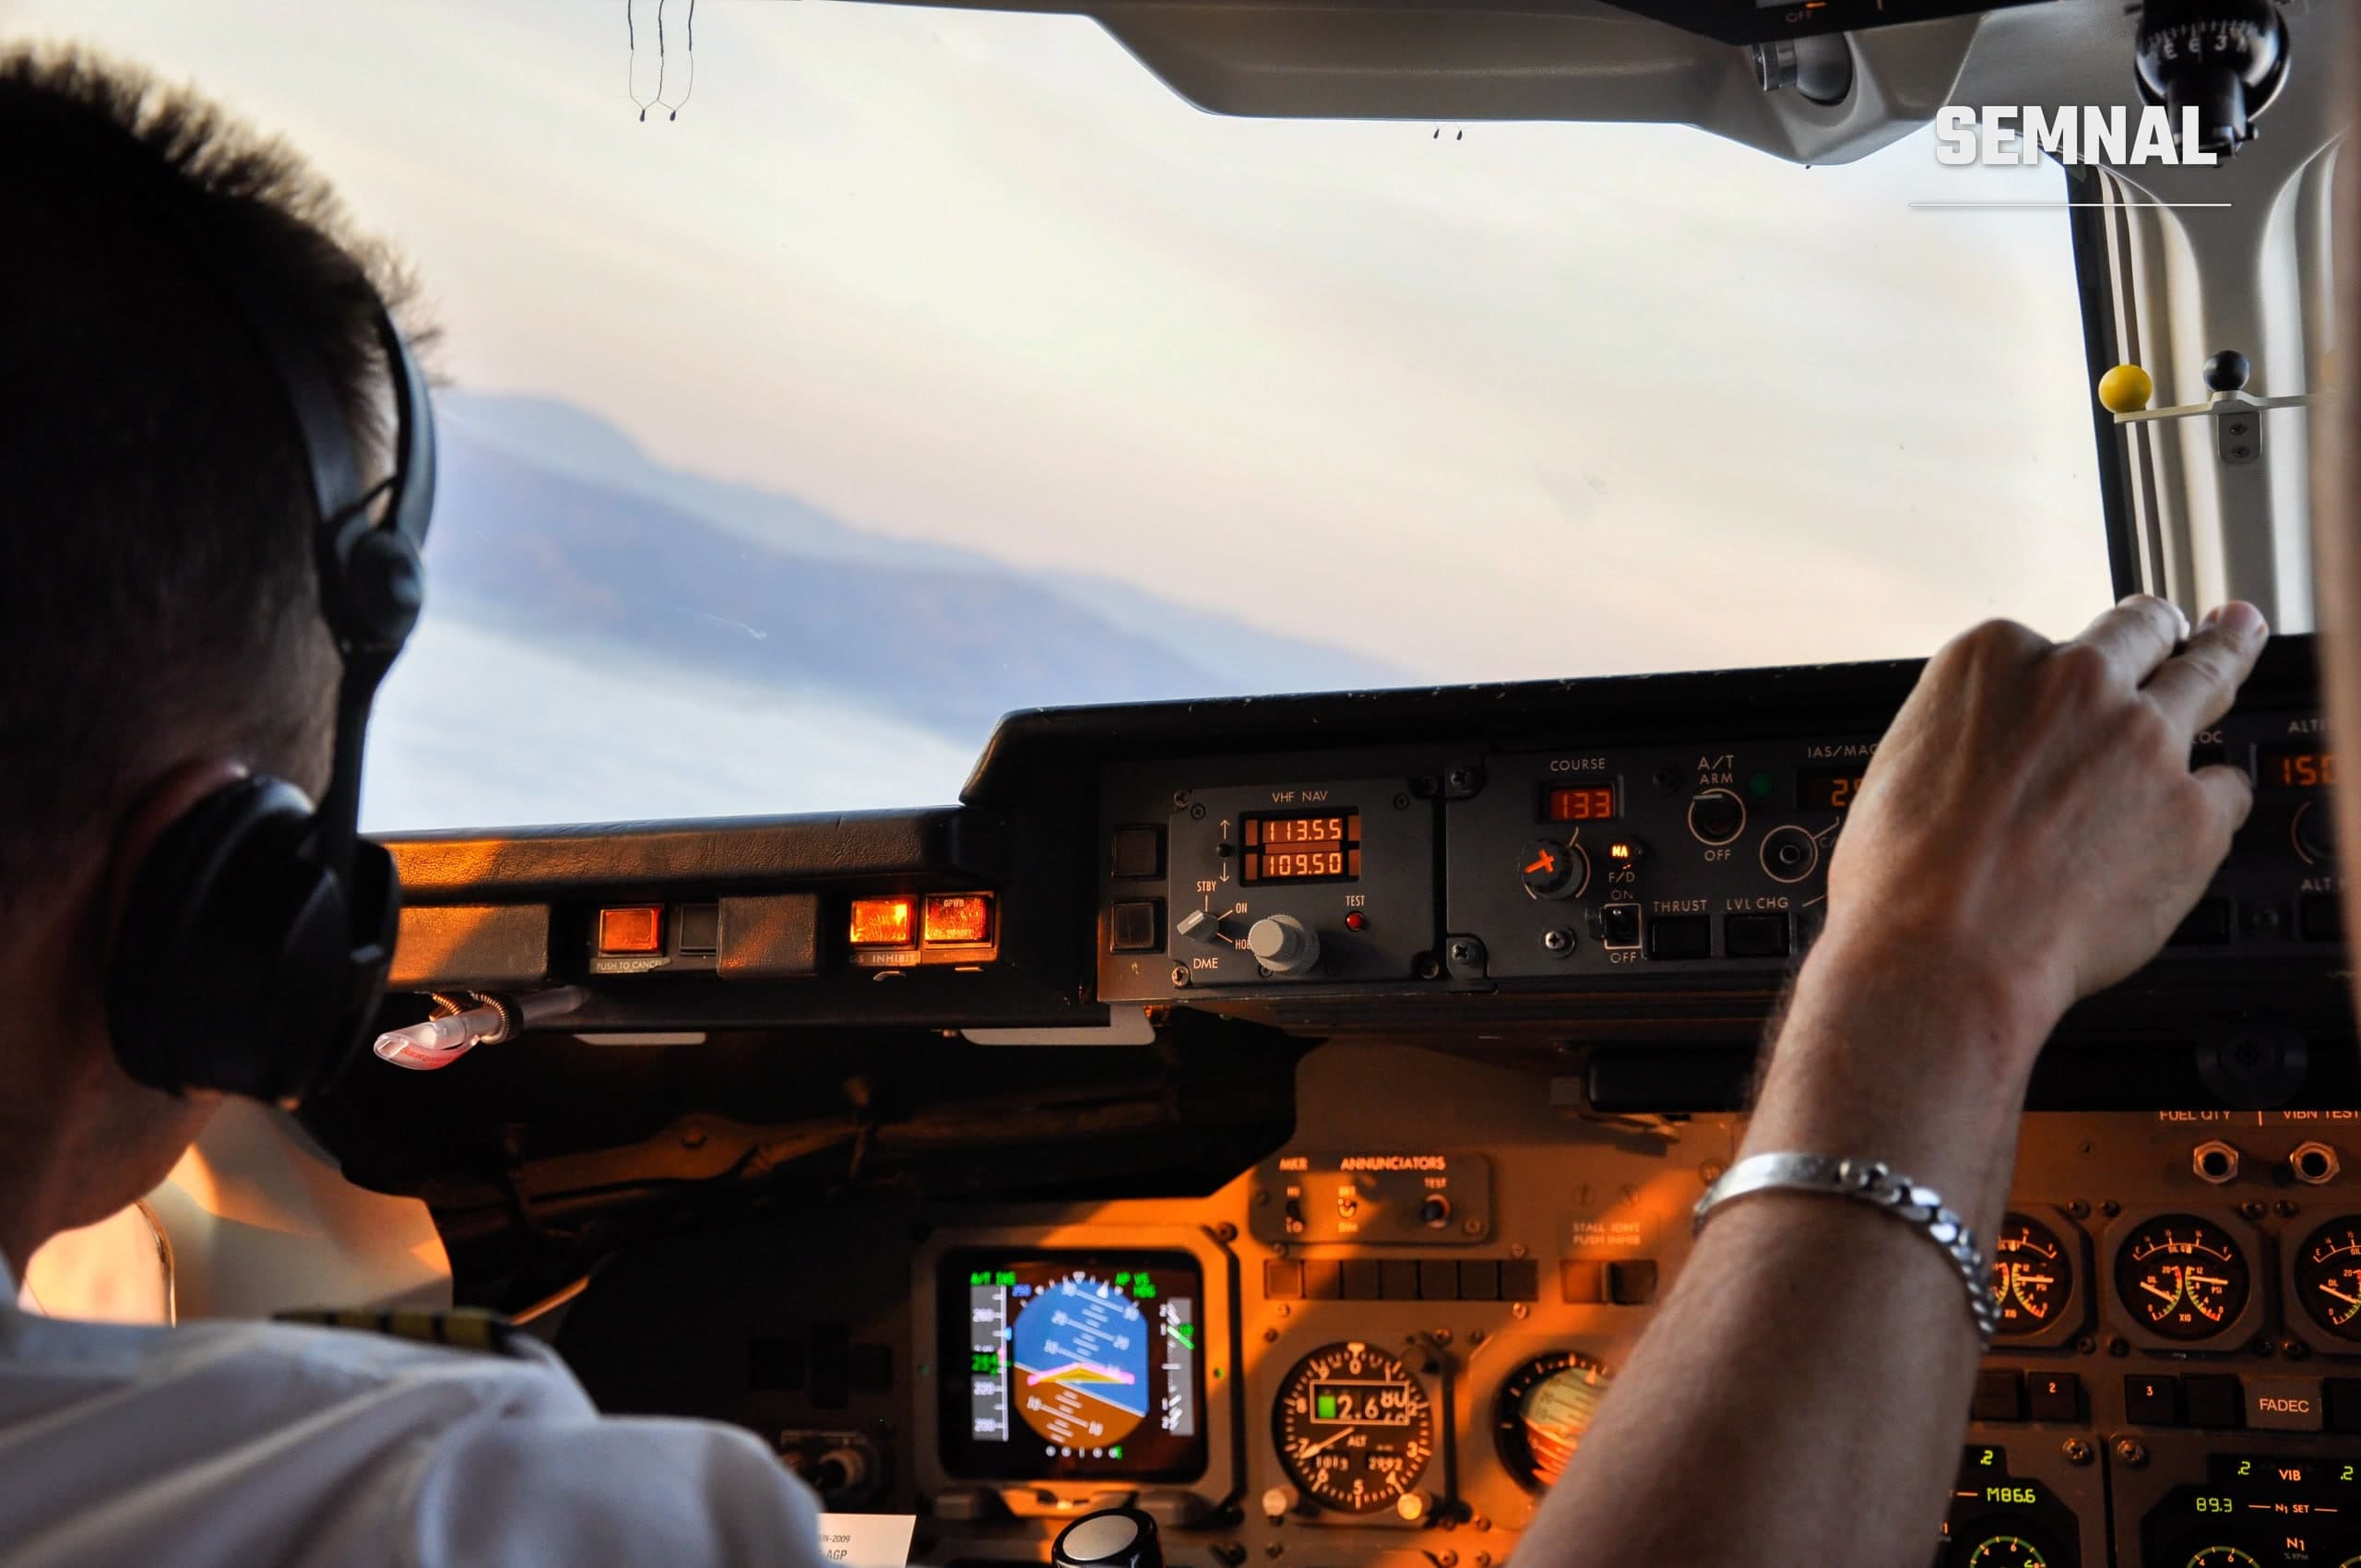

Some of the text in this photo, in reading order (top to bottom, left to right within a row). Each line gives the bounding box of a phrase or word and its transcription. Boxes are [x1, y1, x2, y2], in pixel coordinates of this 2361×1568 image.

[2287, 719, 2327, 736] ALTI
[1808, 742, 1880, 759] IAS/MAC
[1550, 757, 1607, 772] COURSE
[1697, 754, 1735, 771] A/T
[1700, 773, 1734, 785] ARM
[1272, 790, 1328, 803] VHF NAV
[1562, 791, 1611, 820] 133
[1270, 818, 1343, 841] 113.55
[1704, 849, 1732, 861] OFF
[1270, 852, 1343, 876] 109.50
[1608, 871, 1636, 885] F/D
[1196, 880, 1217, 893] STBY
[1346, 895, 1366, 908] TEST
[1610, 889, 1639, 902] ON
[1235, 902, 1248, 914] ON
[1652, 899, 1708, 912] THRUST
[1726, 896, 1790, 911] LVL CHG
[872, 953, 918, 965] INHIBIT
[1193, 957, 1218, 969] DME
[1610, 952, 1637, 964] OFF
[619, 961, 630, 970] TO
[1340, 1155, 1446, 1170] ANNUNCIATORS
[2343, 1269, 2354, 1278] 20
[1349, 1360, 1362, 1375] 0
[2047, 1381, 2154, 1397] 2 3
[2259, 1397, 2310, 1413] FADEC
[1406, 1441, 1418, 1458] 3
[2278, 1468, 2303, 1482] VIB
[1352, 1478, 1364, 1495] 5
[2196, 1497, 2233, 1514] 89.3
[2292, 1503, 2310, 1515] SET
[818, 1534, 851, 1543] UN-2009
[2286, 1537, 2308, 1551] N1
[825, 1549, 848, 1561] AGP
